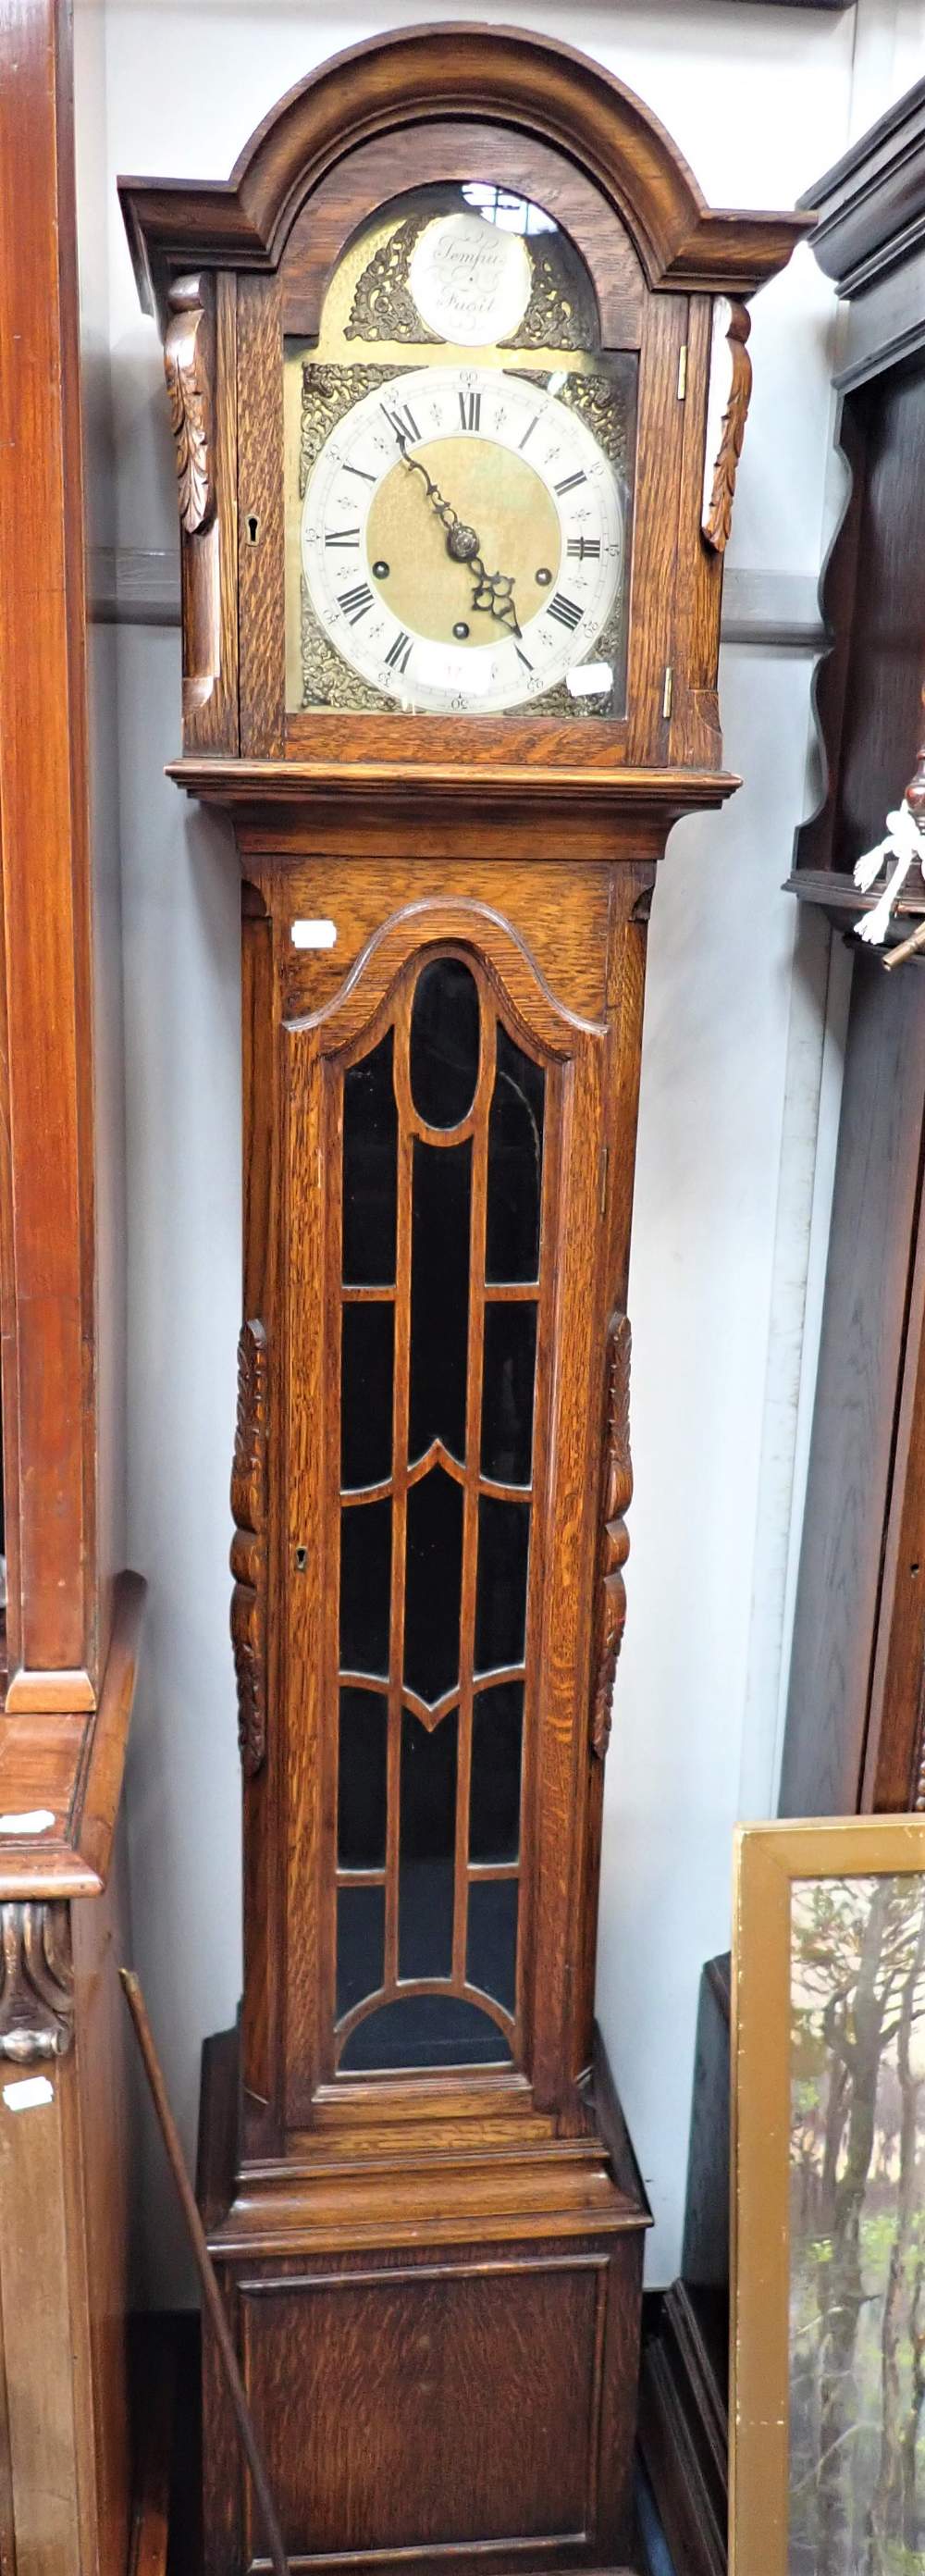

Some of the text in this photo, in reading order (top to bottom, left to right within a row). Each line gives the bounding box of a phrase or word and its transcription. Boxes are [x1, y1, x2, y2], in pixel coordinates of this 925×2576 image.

[457, 391, 481, 431] XII
[518, 415, 539, 450] I
[553, 470, 587, 497] II
[566, 539, 600, 559] III
[337, 583, 376, 625] VIII
[546, 592, 585, 631] IIII
[384, 632, 413, 674] VII
[513, 643, 534, 675] V
